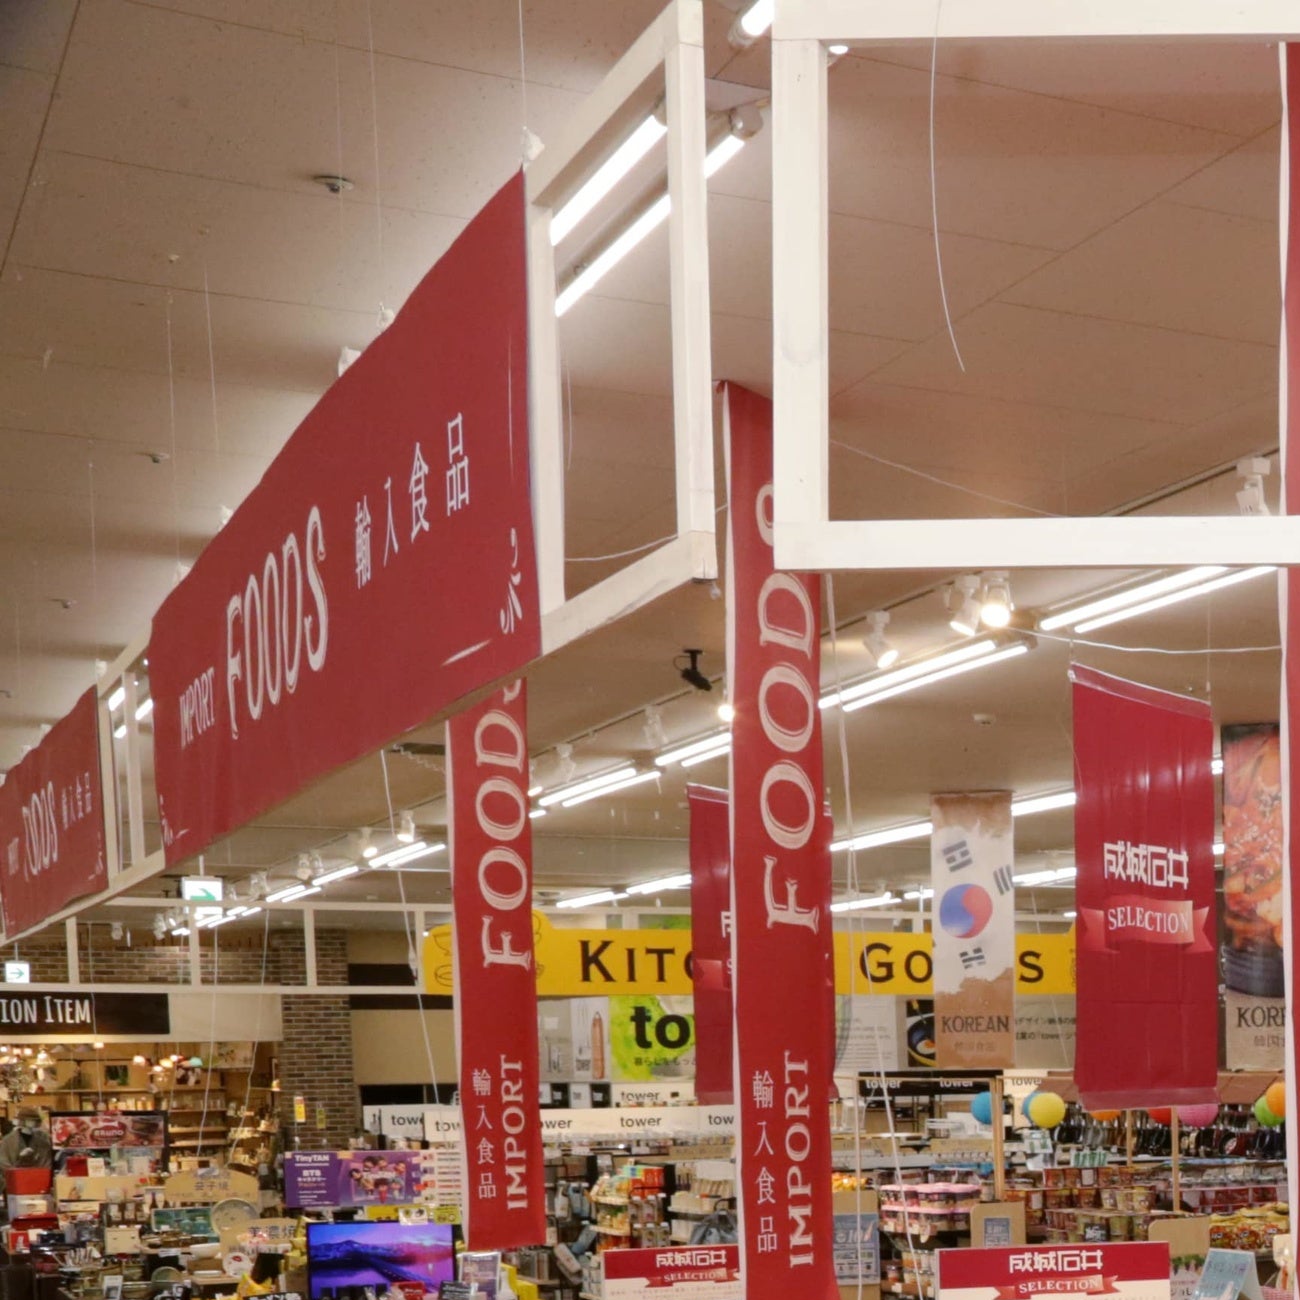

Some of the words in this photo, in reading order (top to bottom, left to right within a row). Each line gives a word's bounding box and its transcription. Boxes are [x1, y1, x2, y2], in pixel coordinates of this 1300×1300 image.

[355, 412, 470, 590] 輸入食品
[180, 667, 216, 749] IMPORT
[227, 505, 328, 740] FOODS
[1102, 840, 1190, 890] 成城石井
[1107, 905, 1191, 933] SELECTION
[44, 996, 92, 1024] ITEM
[941, 1015, 1010, 1034] KOREAN
[471, 1067, 497, 1200] 輸入食品
[499, 1054, 528, 1210] IMPORT
[620, 1114, 662, 1129] tower
[752, 1069, 779, 1255] 輸入食品
[781, 1050, 814, 1267] IMPORT
[1009, 1250, 1103, 1273] 成城石井
[1018, 1276, 1099, 1295] SELECTION
